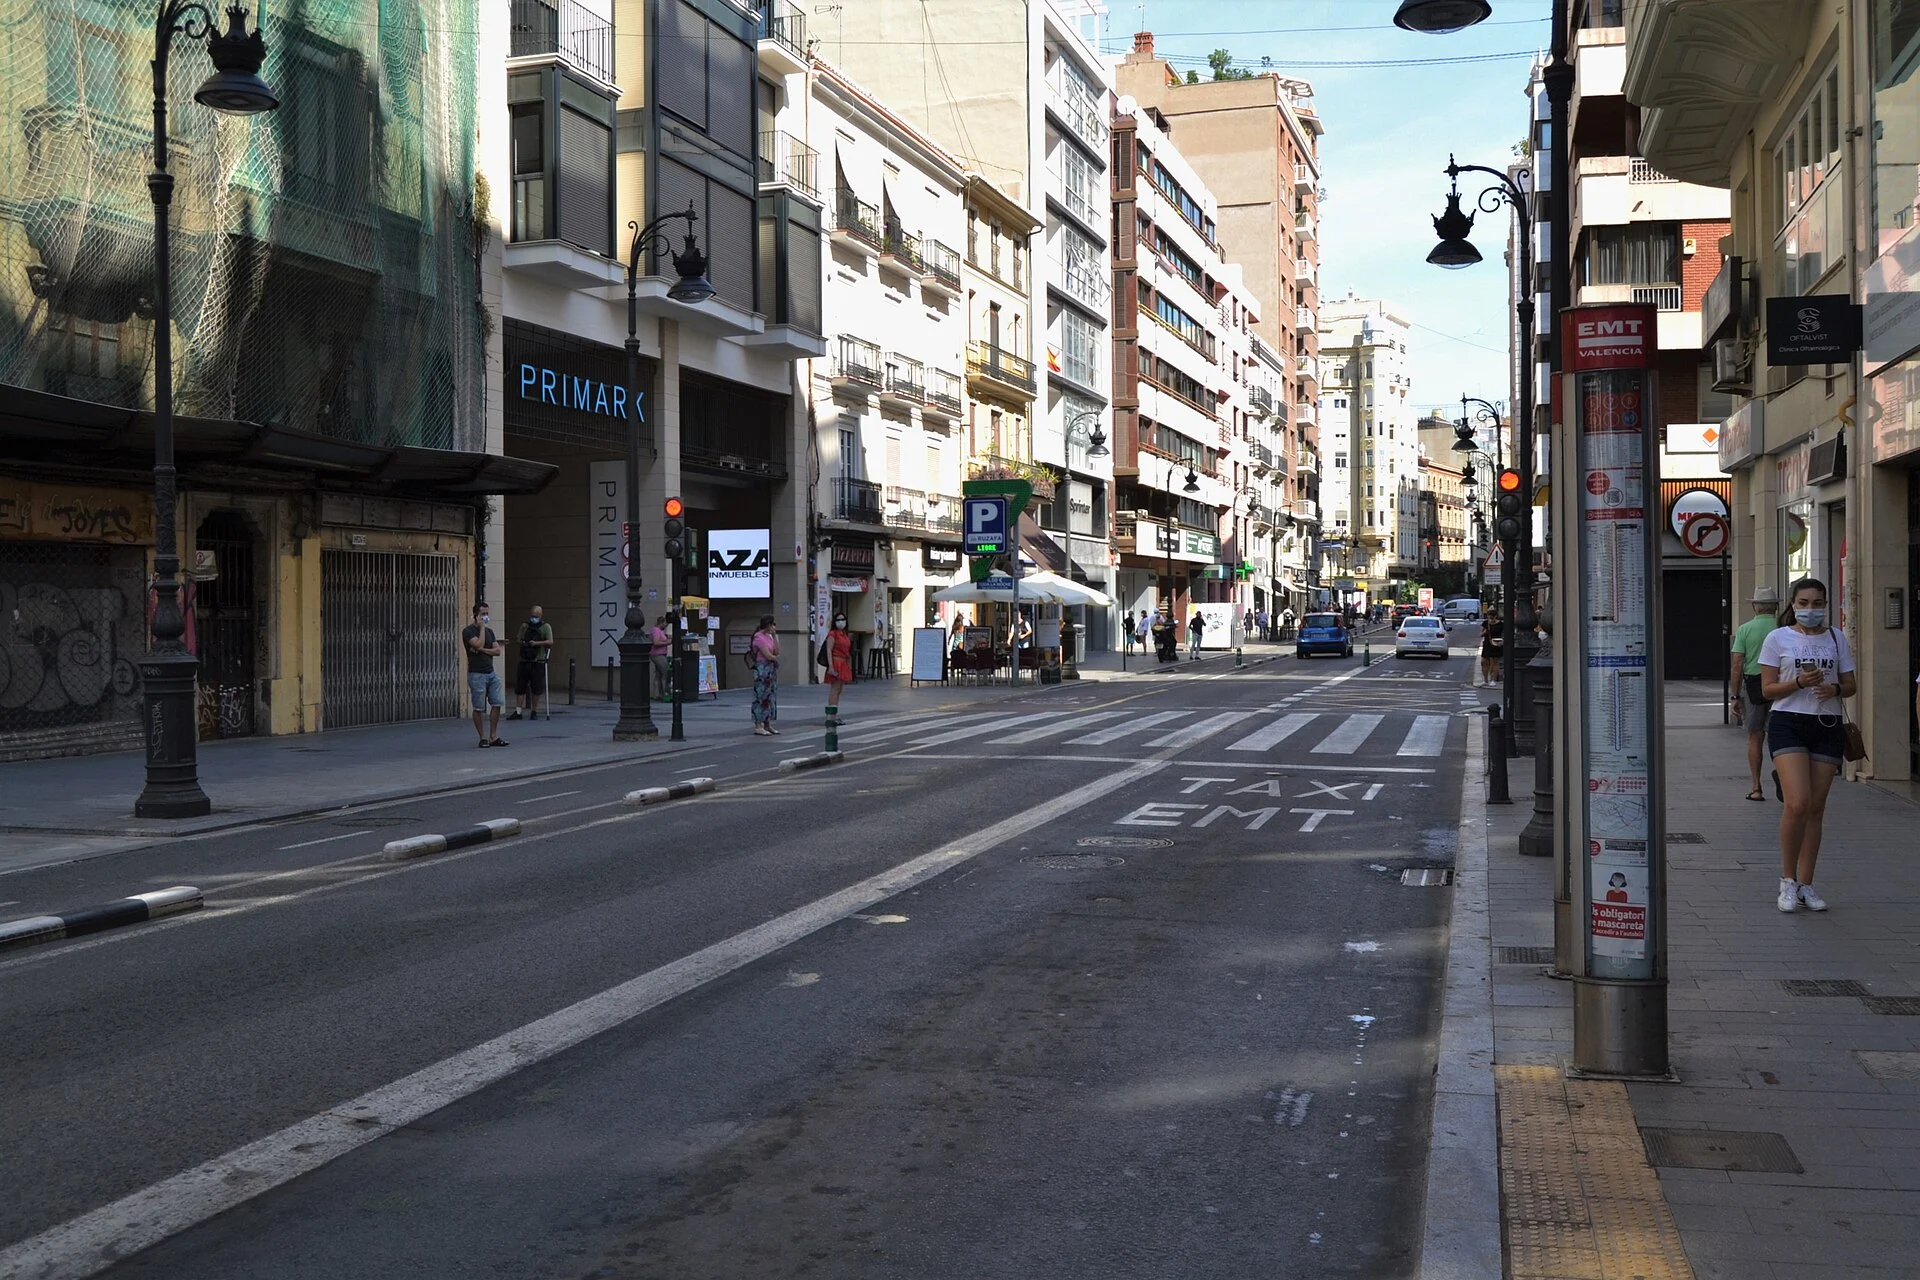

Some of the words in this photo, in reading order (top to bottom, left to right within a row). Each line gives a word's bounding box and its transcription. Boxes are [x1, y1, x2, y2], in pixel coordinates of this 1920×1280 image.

[1578, 320, 1642, 336] EMT
[1789, 333, 1829, 341] OFTALVIST
[1579, 347, 1642, 357] VALENCIA
[521, 364, 645, 423] PRIMARK
[972, 502, 998, 532] P
[599, 481, 617, 646] PRIMARK
[710, 549, 768, 571] AZA
[1180, 776, 1384, 800] TAXI
[1112, 802, 1355, 832] EMT
[1597, 920, 1644, 930] mascareta
[1600, 907, 1645, 921] obligatori
